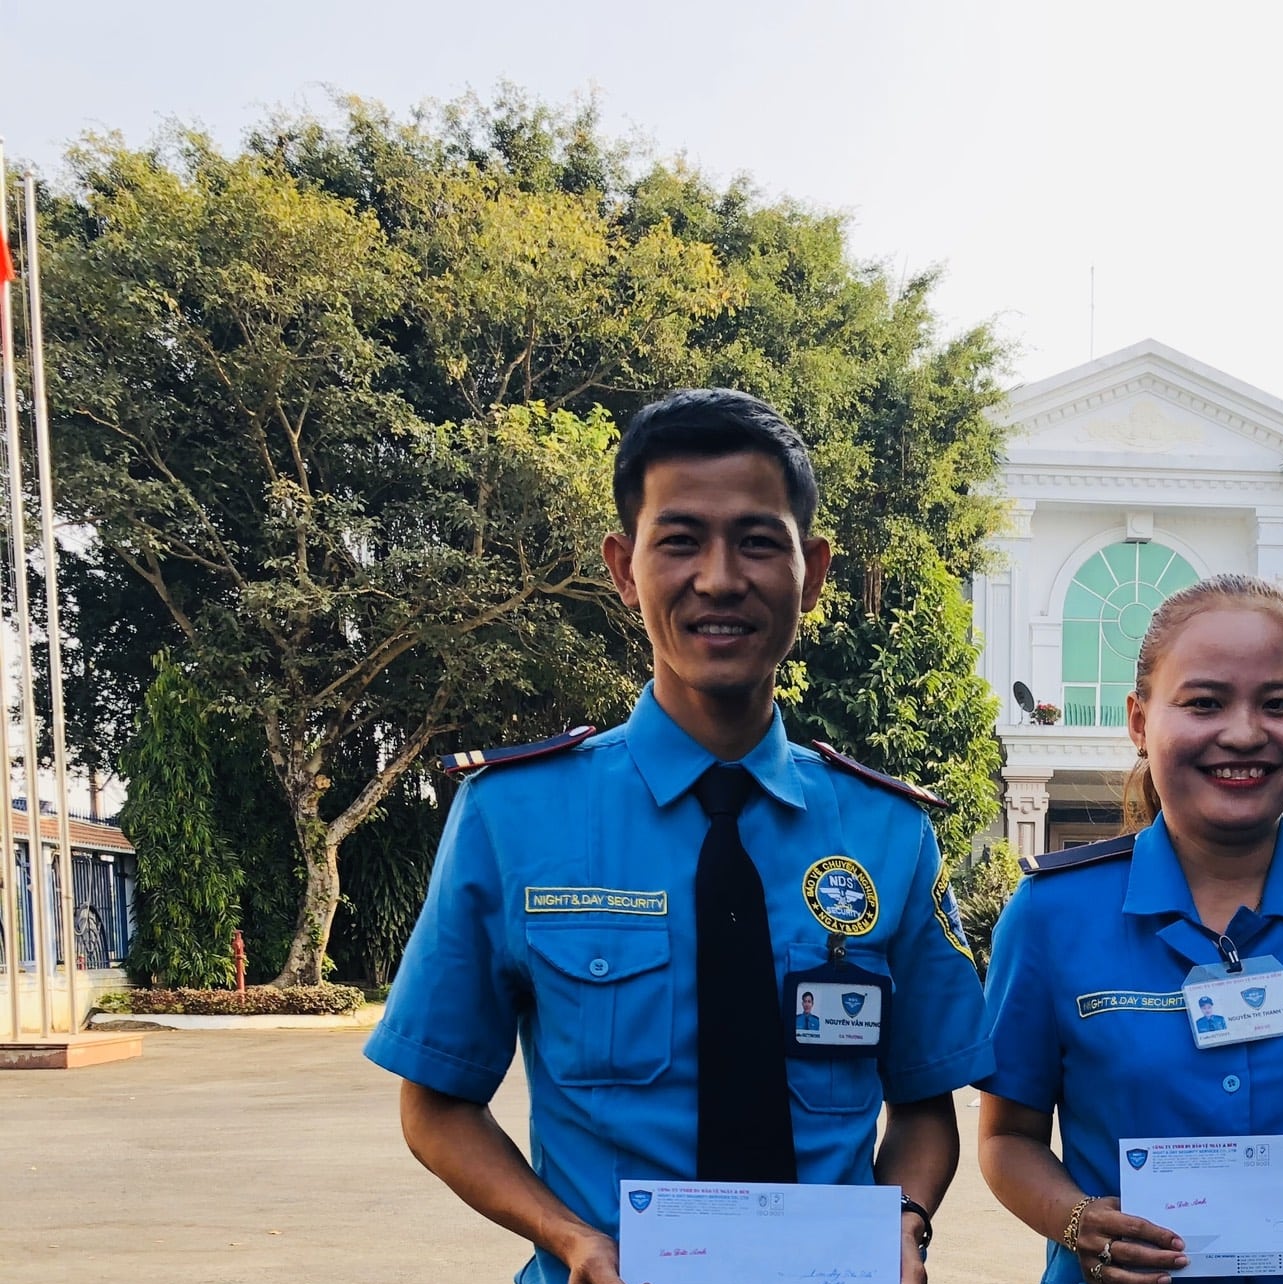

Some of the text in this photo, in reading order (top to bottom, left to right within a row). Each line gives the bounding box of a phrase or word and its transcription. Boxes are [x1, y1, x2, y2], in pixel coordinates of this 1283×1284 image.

[829, 875, 854, 889] NDS
[607, 895, 664, 909] SECURITY
[826, 906, 861, 918] SECURITY
[1141, 997, 1184, 1007] SECURIT
